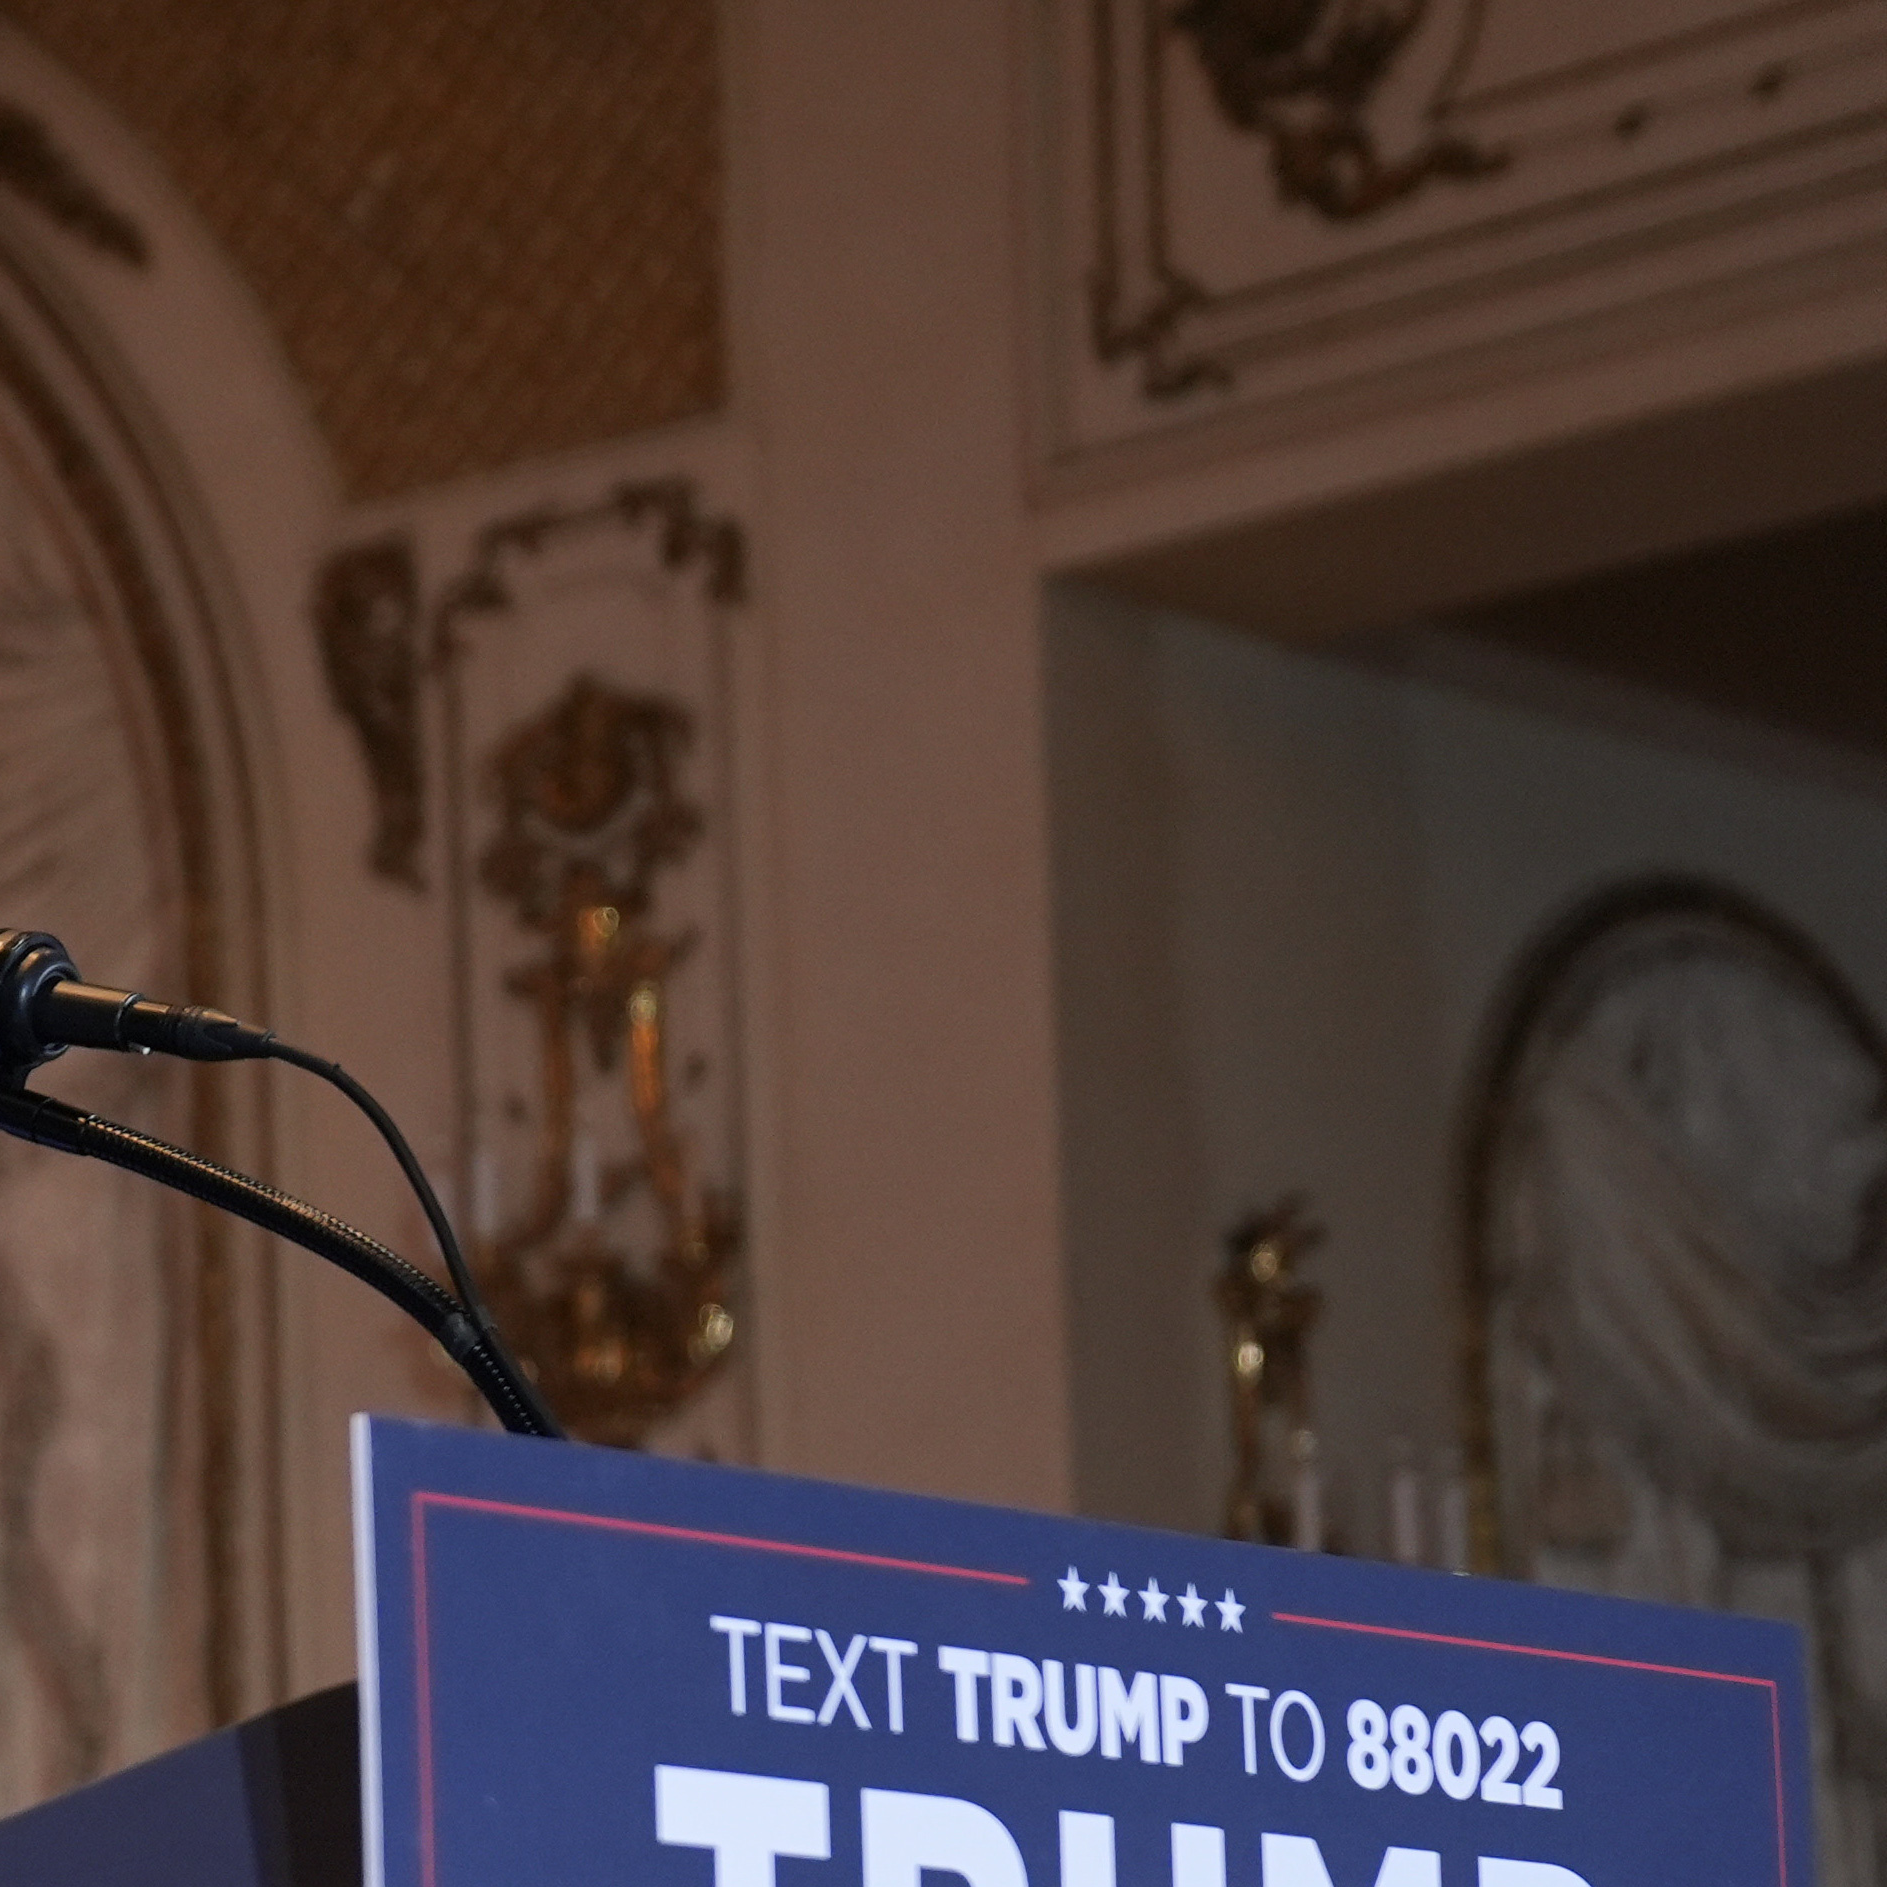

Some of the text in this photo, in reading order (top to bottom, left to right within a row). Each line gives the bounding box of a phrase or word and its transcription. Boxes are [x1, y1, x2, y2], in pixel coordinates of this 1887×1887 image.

[708, 1614, 1564, 1811] TEXT TRUMP TO 88022
